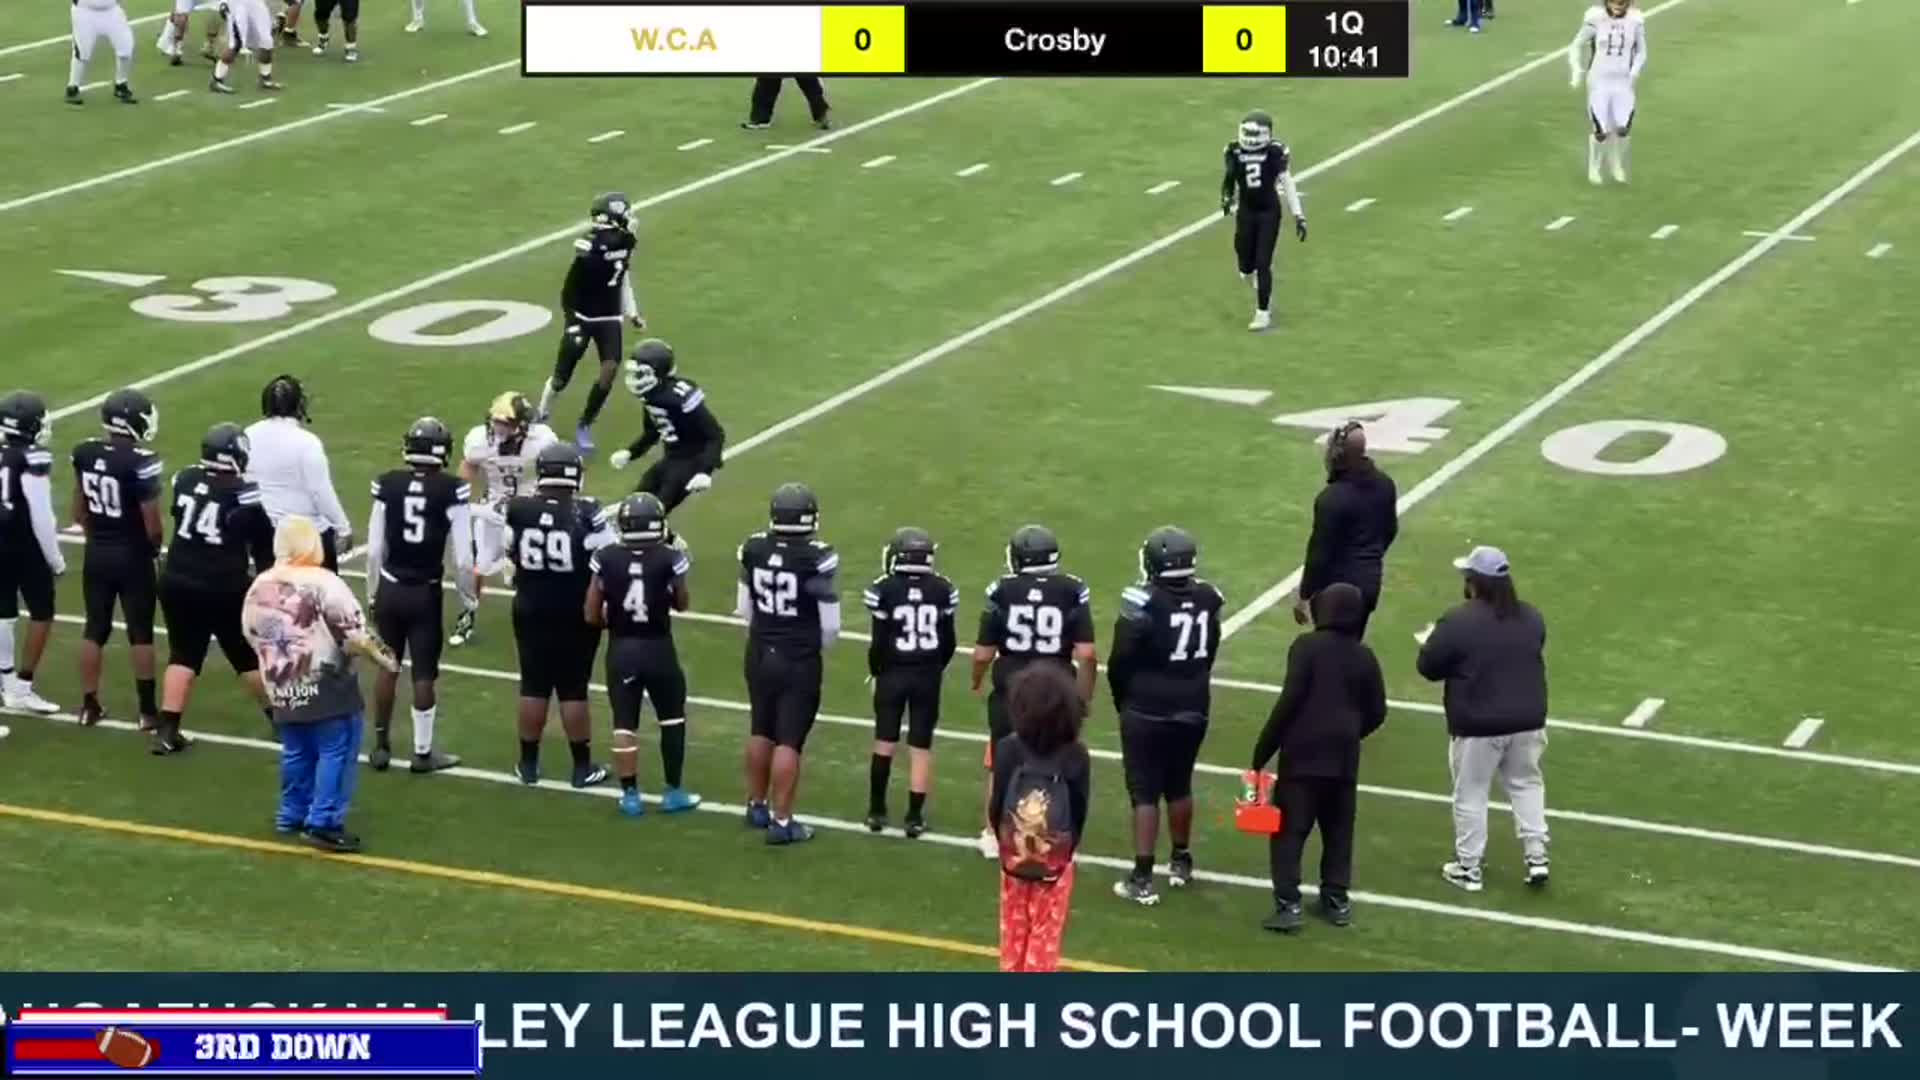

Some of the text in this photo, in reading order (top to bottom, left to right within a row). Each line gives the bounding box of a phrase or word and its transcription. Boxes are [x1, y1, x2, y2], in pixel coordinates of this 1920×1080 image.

[1244, 162, 1263, 188] 2
[81, 471, 122, 518] 50
[176, 493, 223, 545] 74
[402, 495, 426, 544] 5
[518, 528, 574, 573] 69
[622, 579, 649, 623] 4
[752, 567, 798, 617] 52
[892, 604, 939, 652] 39
[1005, 605, 1063, 655] 59
[1169, 609, 1209, 662] 71
